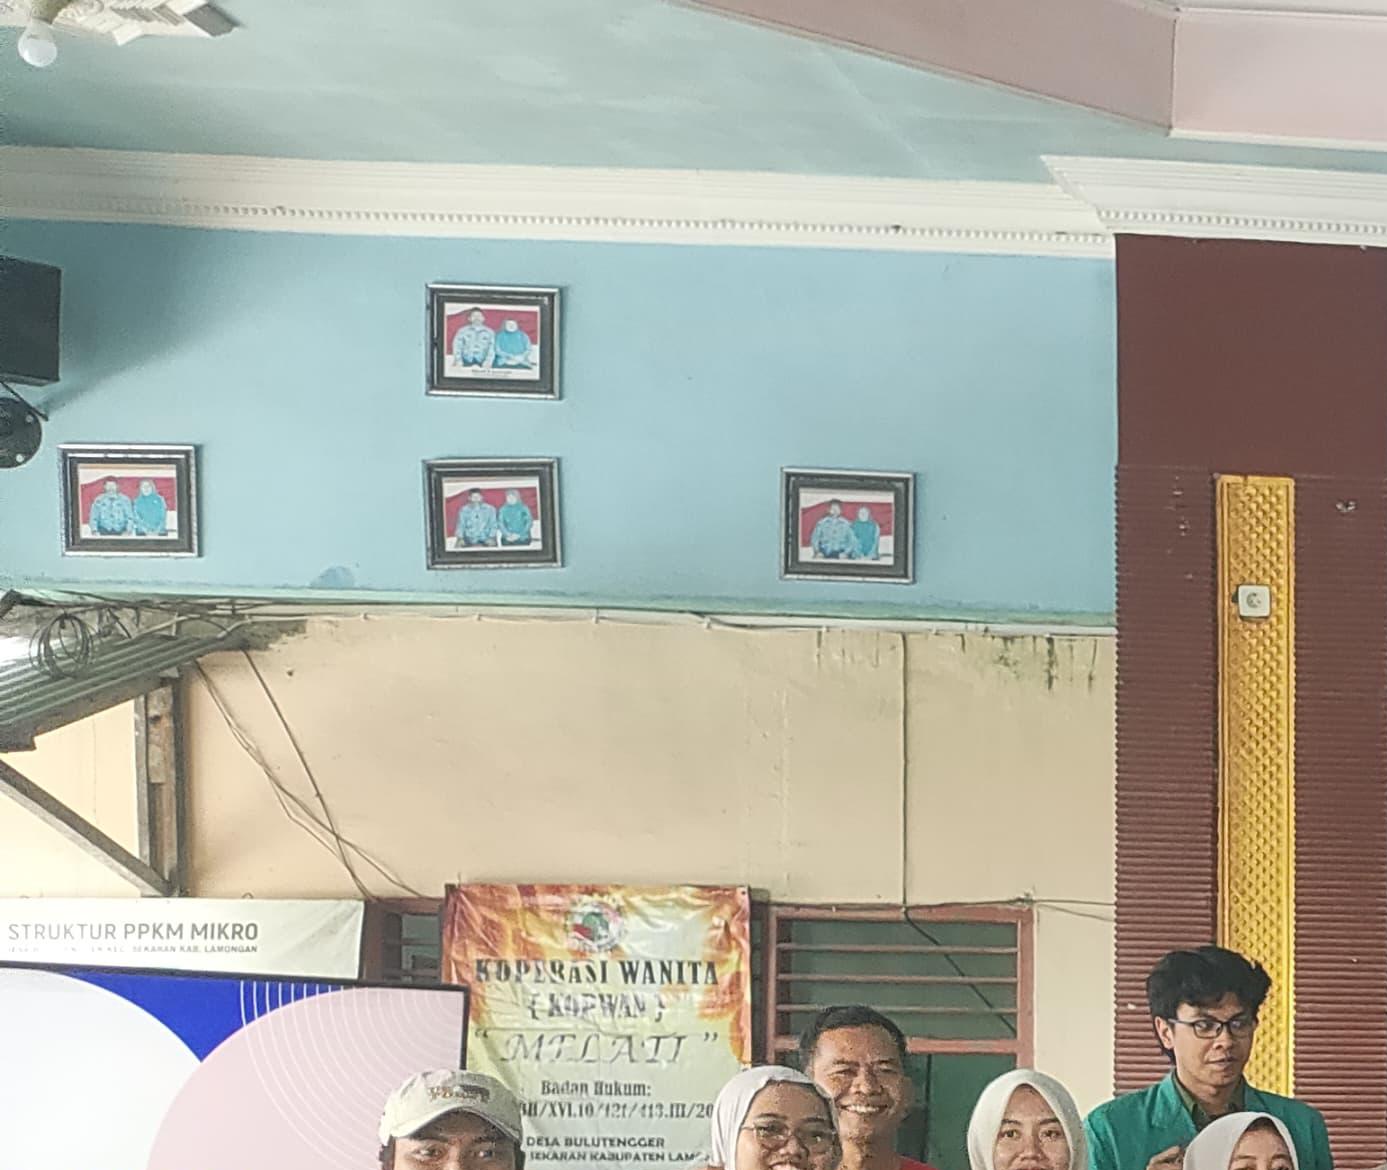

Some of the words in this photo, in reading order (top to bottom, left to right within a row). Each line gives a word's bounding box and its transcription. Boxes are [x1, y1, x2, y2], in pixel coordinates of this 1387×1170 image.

[8, 922, 117, 941] STRUKTUR
[123, 922, 184, 941] PPKM
[190, 922, 259, 941] MIKRO
[204, 945, 258, 953] LAMONGAN
[476, 959, 608, 985] KOPERASI
[620, 960, 719, 985] WANITA
[541, 1080, 589, 1097] Badan
[526, 1137, 560, 1147] DESA
[564, 1137, 665, 1148] BULUTENGGER
